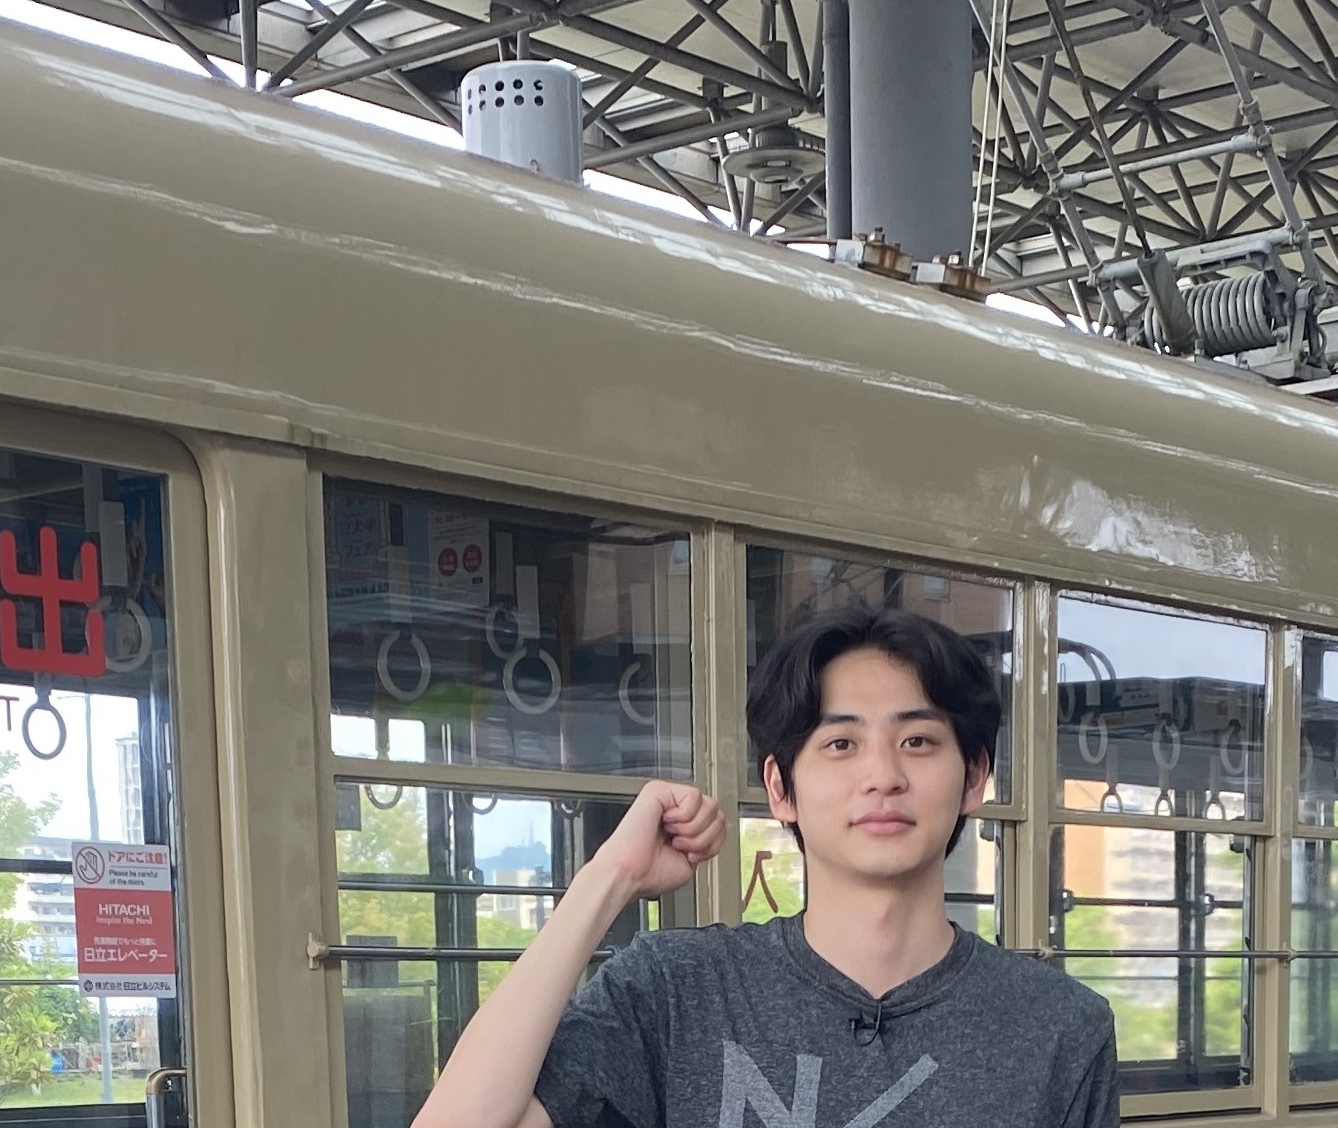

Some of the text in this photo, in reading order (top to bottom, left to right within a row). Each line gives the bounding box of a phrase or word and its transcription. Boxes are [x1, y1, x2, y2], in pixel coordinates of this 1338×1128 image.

[98, 903, 151, 916] HITACHI
[84, 946, 168, 963] 日立エレベーター
